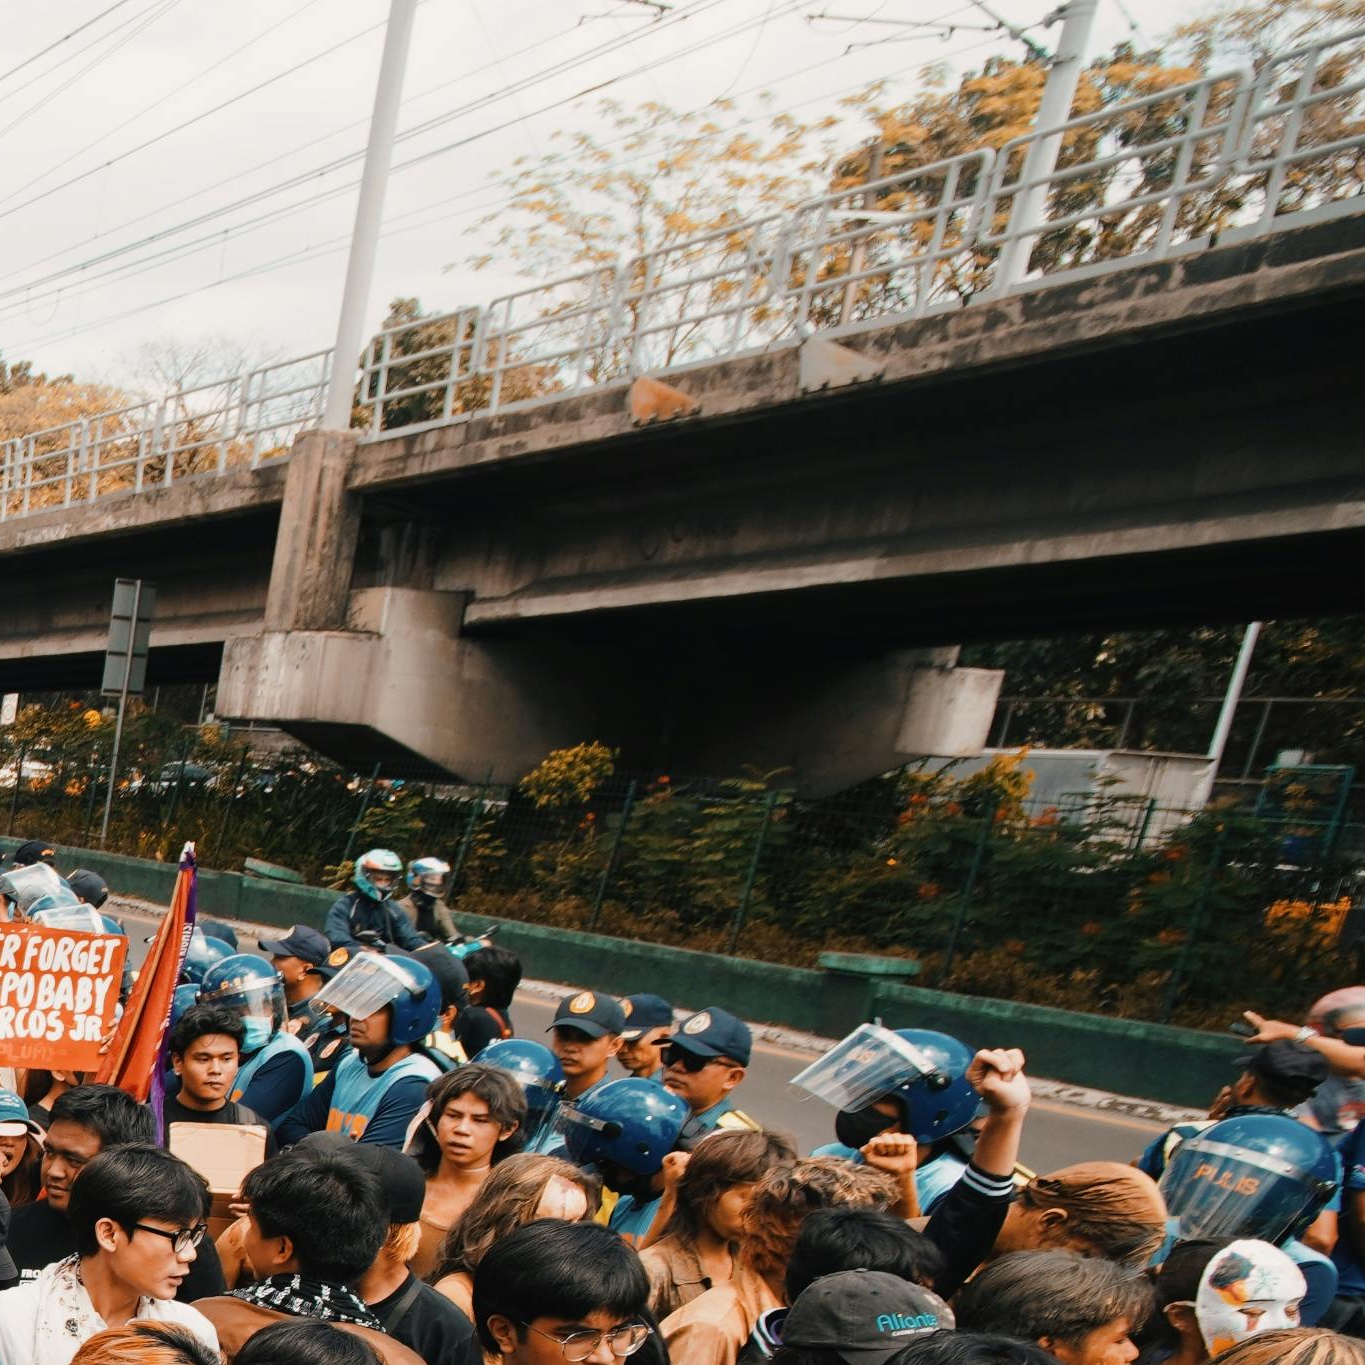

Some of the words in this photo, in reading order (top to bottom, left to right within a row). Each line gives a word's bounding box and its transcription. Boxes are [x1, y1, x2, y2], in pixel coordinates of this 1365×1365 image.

[22, 935, 121, 975] FORGET
[35, 973, 114, 1016] BABY
[69, 1013, 103, 1042] JR
[20, 1268, 42, 1279] FRO
